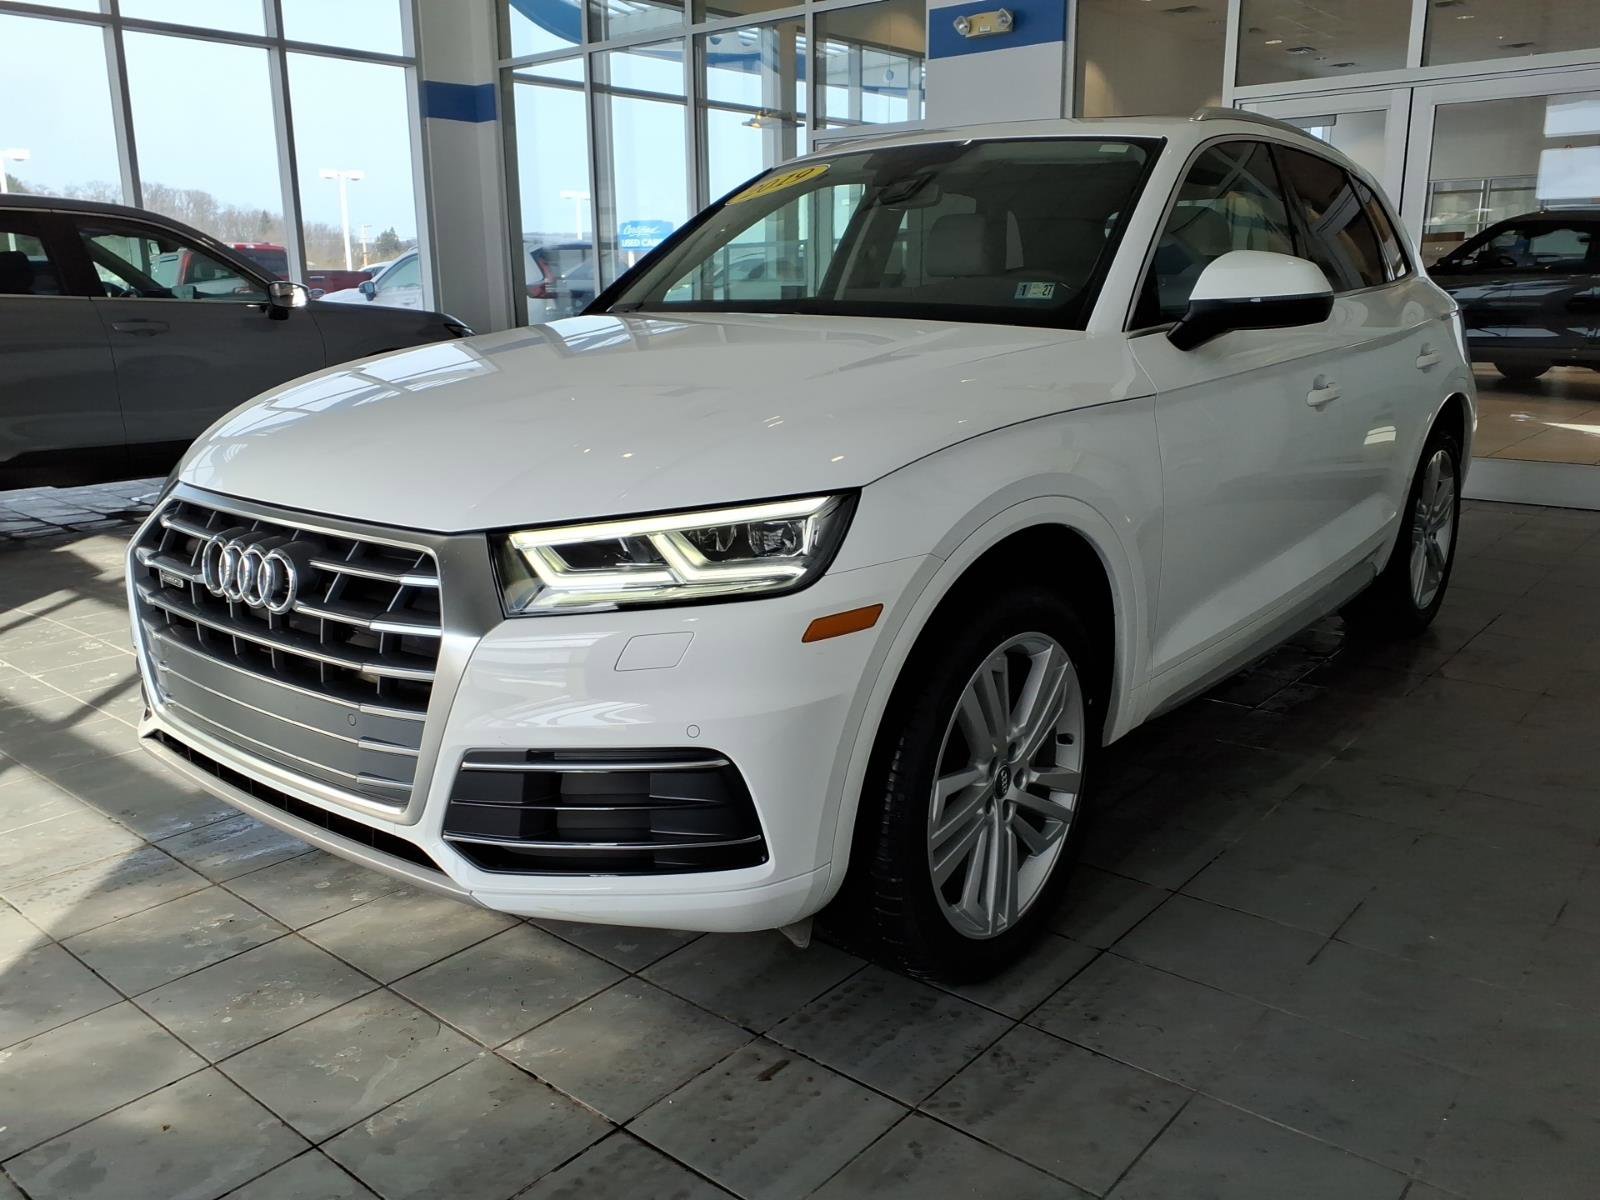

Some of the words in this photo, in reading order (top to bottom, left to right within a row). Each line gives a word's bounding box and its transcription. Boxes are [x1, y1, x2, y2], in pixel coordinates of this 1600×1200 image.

[738, 167, 816, 201] 2019
[621, 238, 641, 248] USED
[1042, 284, 1054, 296] 27
